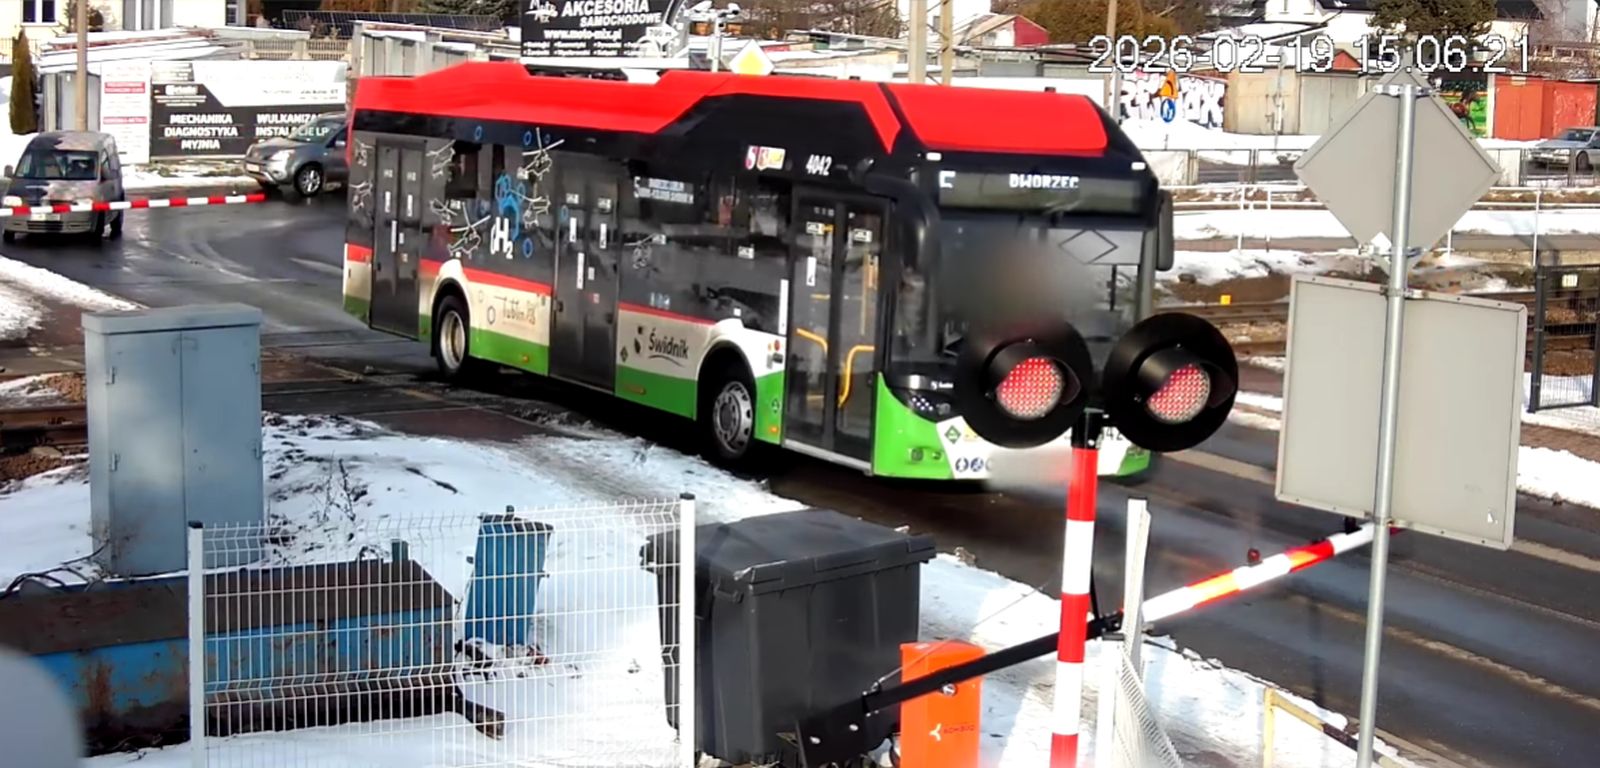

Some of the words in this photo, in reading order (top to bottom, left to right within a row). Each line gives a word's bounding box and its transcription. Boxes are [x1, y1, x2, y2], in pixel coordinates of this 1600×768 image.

[562, 0, 650, 17] AKCESORIA
[580, 12, 662, 28] SAMOCHODOWE
[543, 28, 622, 41] www.moto-mix.pl
[170, 113, 233, 124] MECHANIKA
[256, 113, 320, 124] WULKANIZA
[164, 126, 239, 137] DIAGNOSTYKA
[316, 126, 330, 137] LP
[181, 139, 220, 150] MYJNIA
[805, 154, 832, 176] 4042
[1009, 173, 1080, 188] DWORZEC
[649, 327, 689, 360] Świdnik
[1101, 427, 1123, 441] 42
